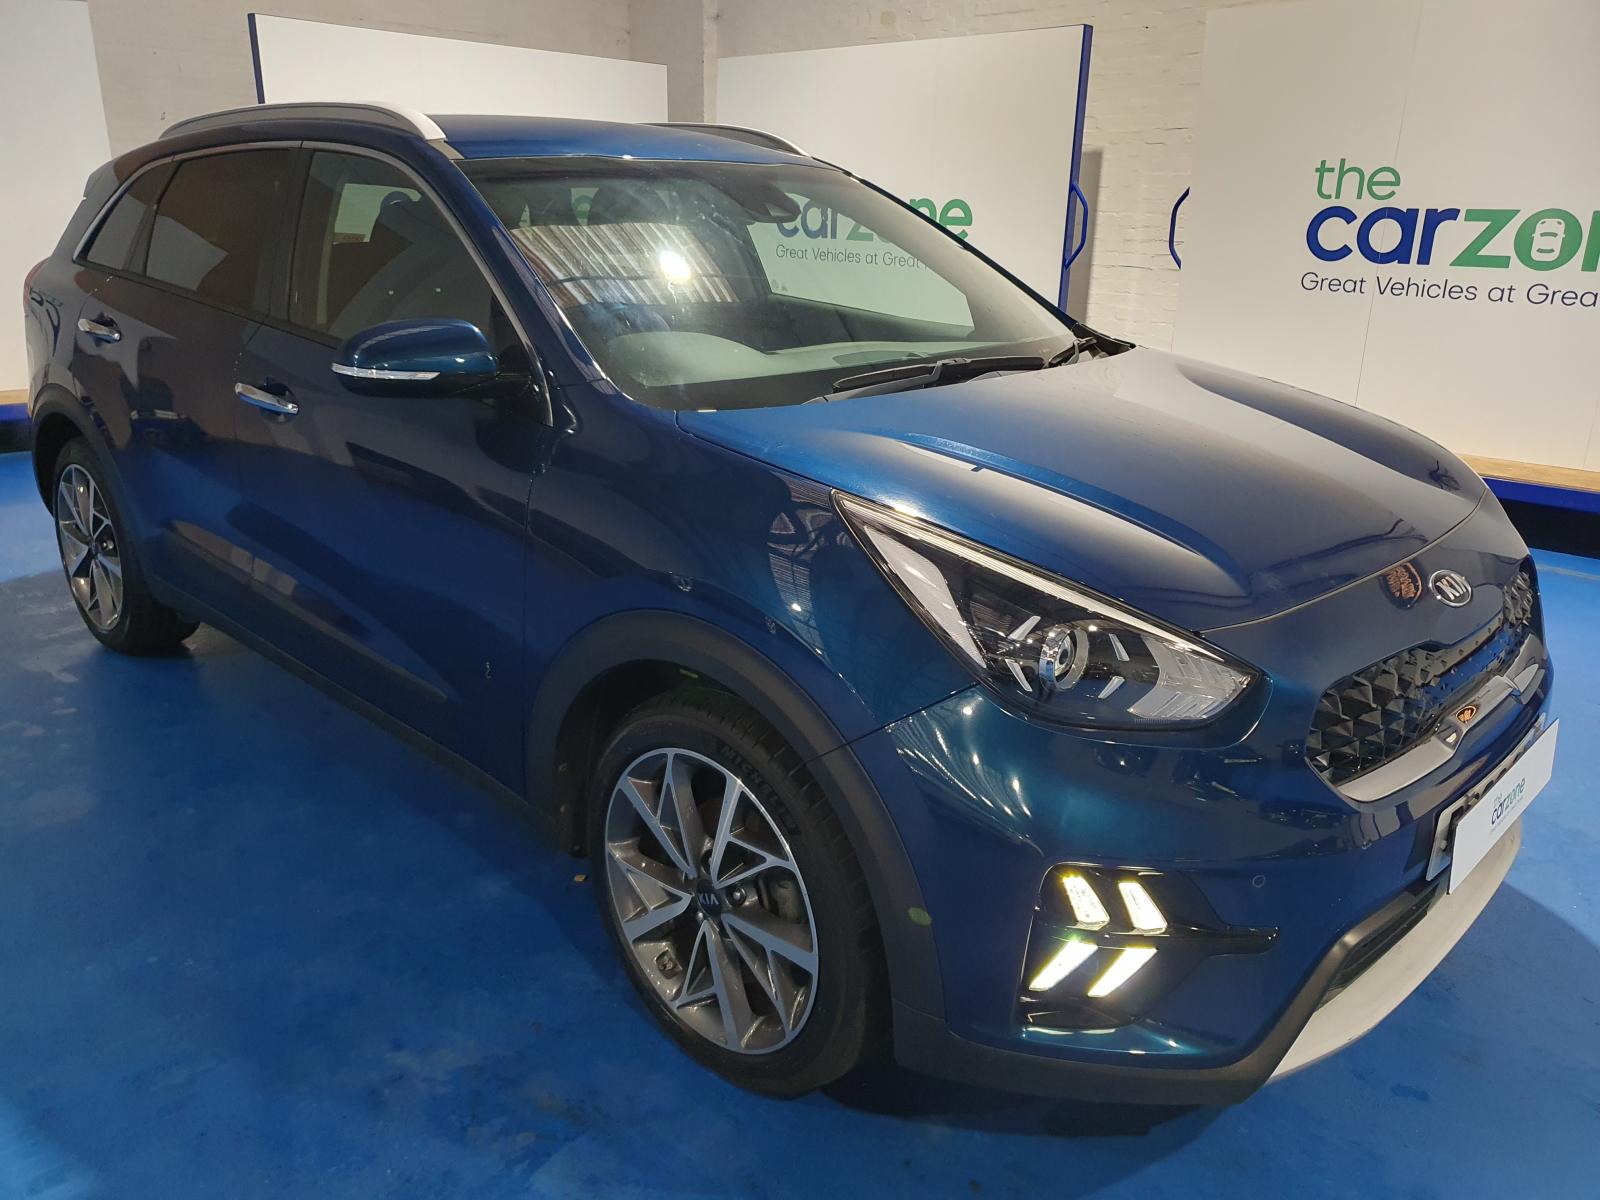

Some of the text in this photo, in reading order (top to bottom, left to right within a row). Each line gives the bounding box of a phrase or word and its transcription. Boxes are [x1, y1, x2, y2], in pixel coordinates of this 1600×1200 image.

[1315, 158, 1401, 200] the
[776, 243, 808, 260] Great
[812, 247, 861, 264] Vehicles
[865, 252, 878, 265] at
[882, 251, 920, 269] Great
[1301, 271, 1367, 294] Great
[1376, 276, 1478, 301] Vehicles
[1488, 284, 1516, 303] at
[1435, 573, 1467, 601] KIA
[1491, 778, 1526, 825] carzone
[697, 891, 720, 905] KIA
